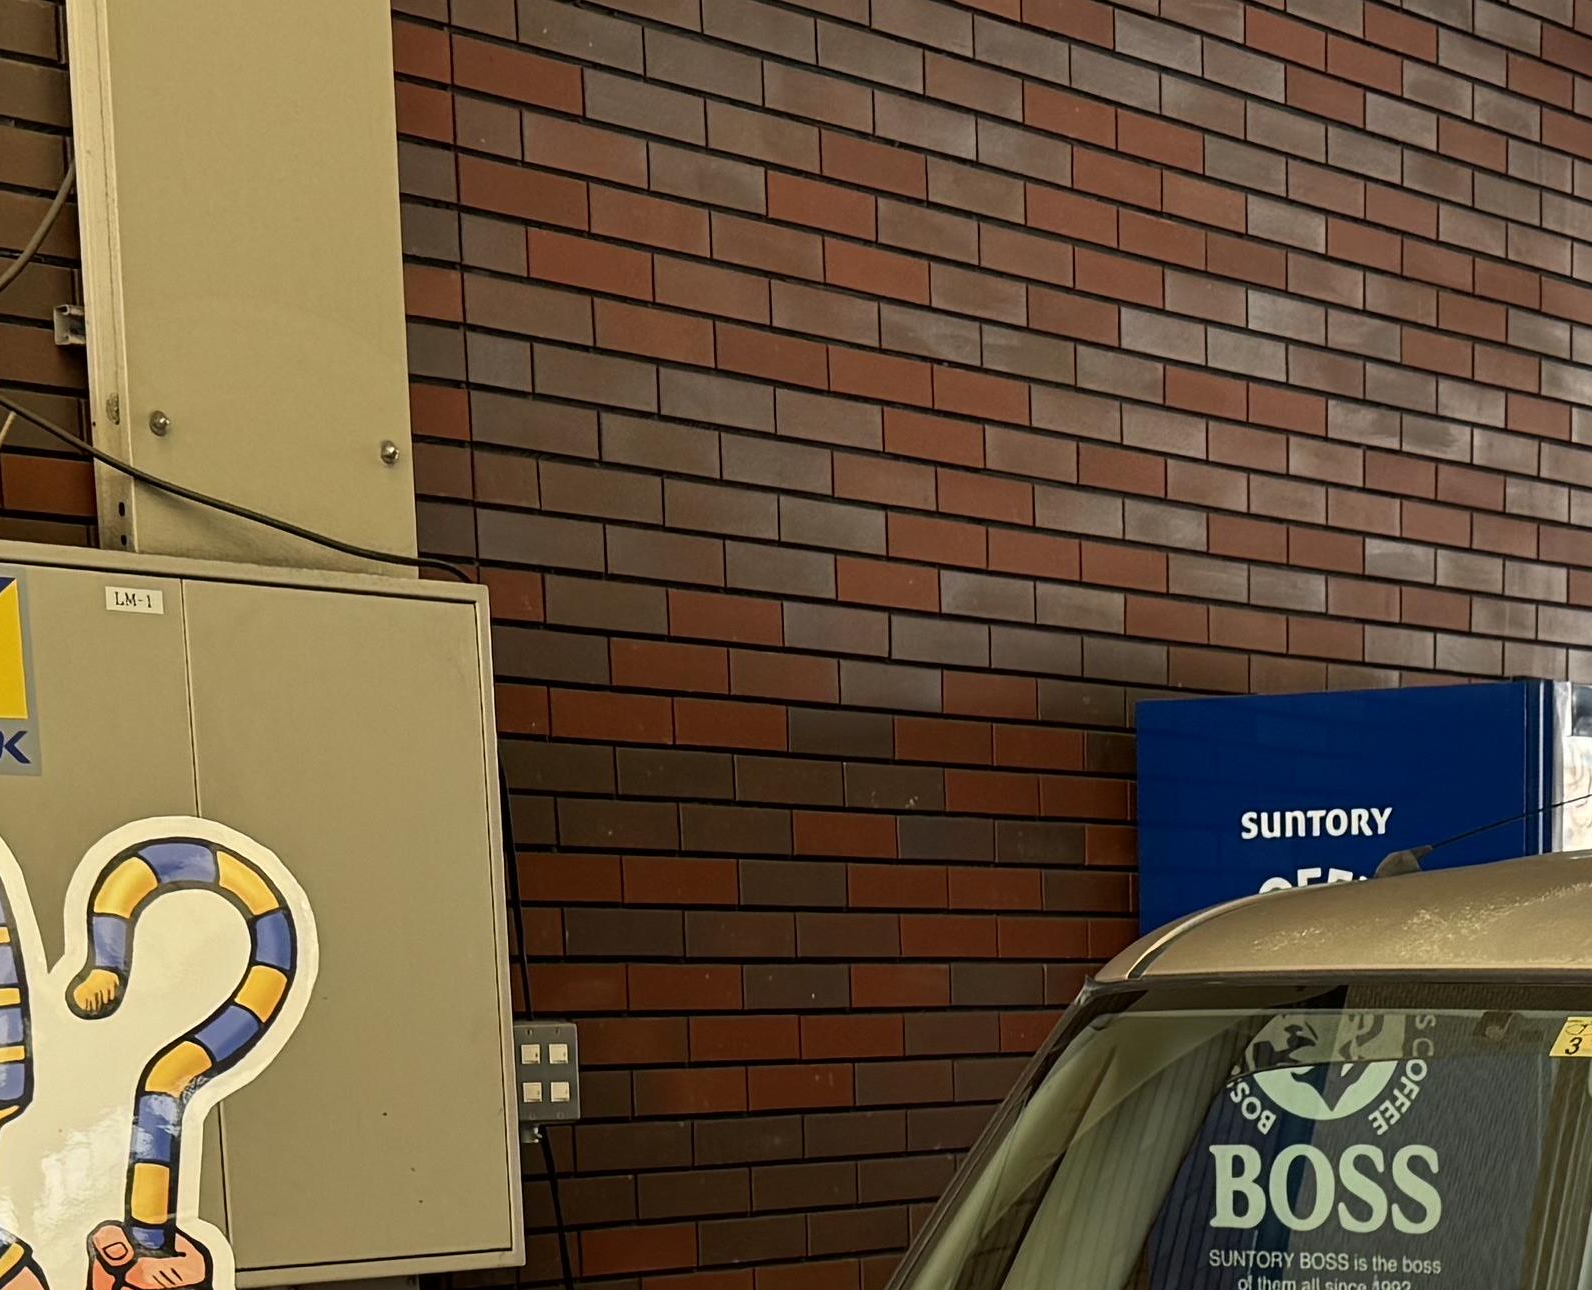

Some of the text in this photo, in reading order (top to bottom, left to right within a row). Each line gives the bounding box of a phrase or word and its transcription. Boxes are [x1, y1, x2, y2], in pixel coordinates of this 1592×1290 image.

[114, 591, 152, 608] LM-1
[1241, 807, 1393, 840] SUNTORY
[1565, 1037, 1583, 1055] 3
[1226, 1064, 1277, 1135] BOS
[1209, 1143, 1442, 1234] BOSS
[1209, 1249, 1442, 1275] SUNTORY BOSS is the boss
